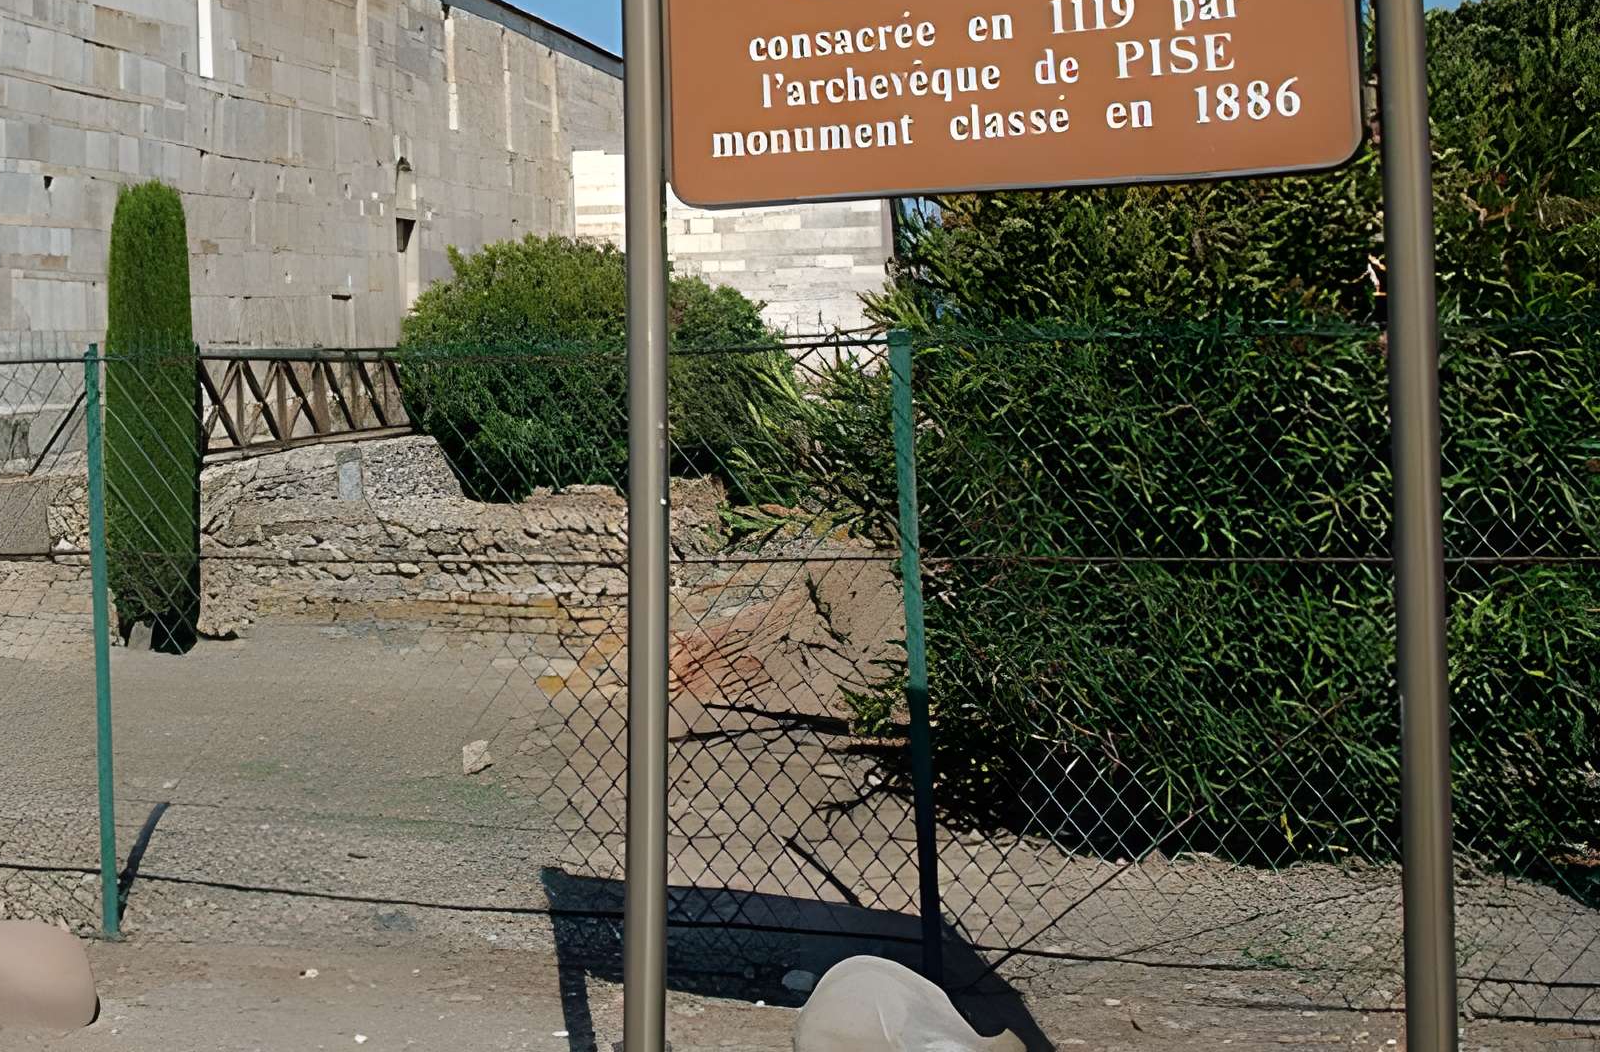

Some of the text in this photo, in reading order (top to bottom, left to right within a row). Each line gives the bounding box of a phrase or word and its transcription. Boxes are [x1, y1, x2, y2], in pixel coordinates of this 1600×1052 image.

[748, 10, 936, 62] consacrée
[967, 13, 1014, 43] en
[1034, 48, 1079, 85] de
[1114, 32, 1236, 80] PISE
[711, 76, 1302, 158] monument classé en 1886
